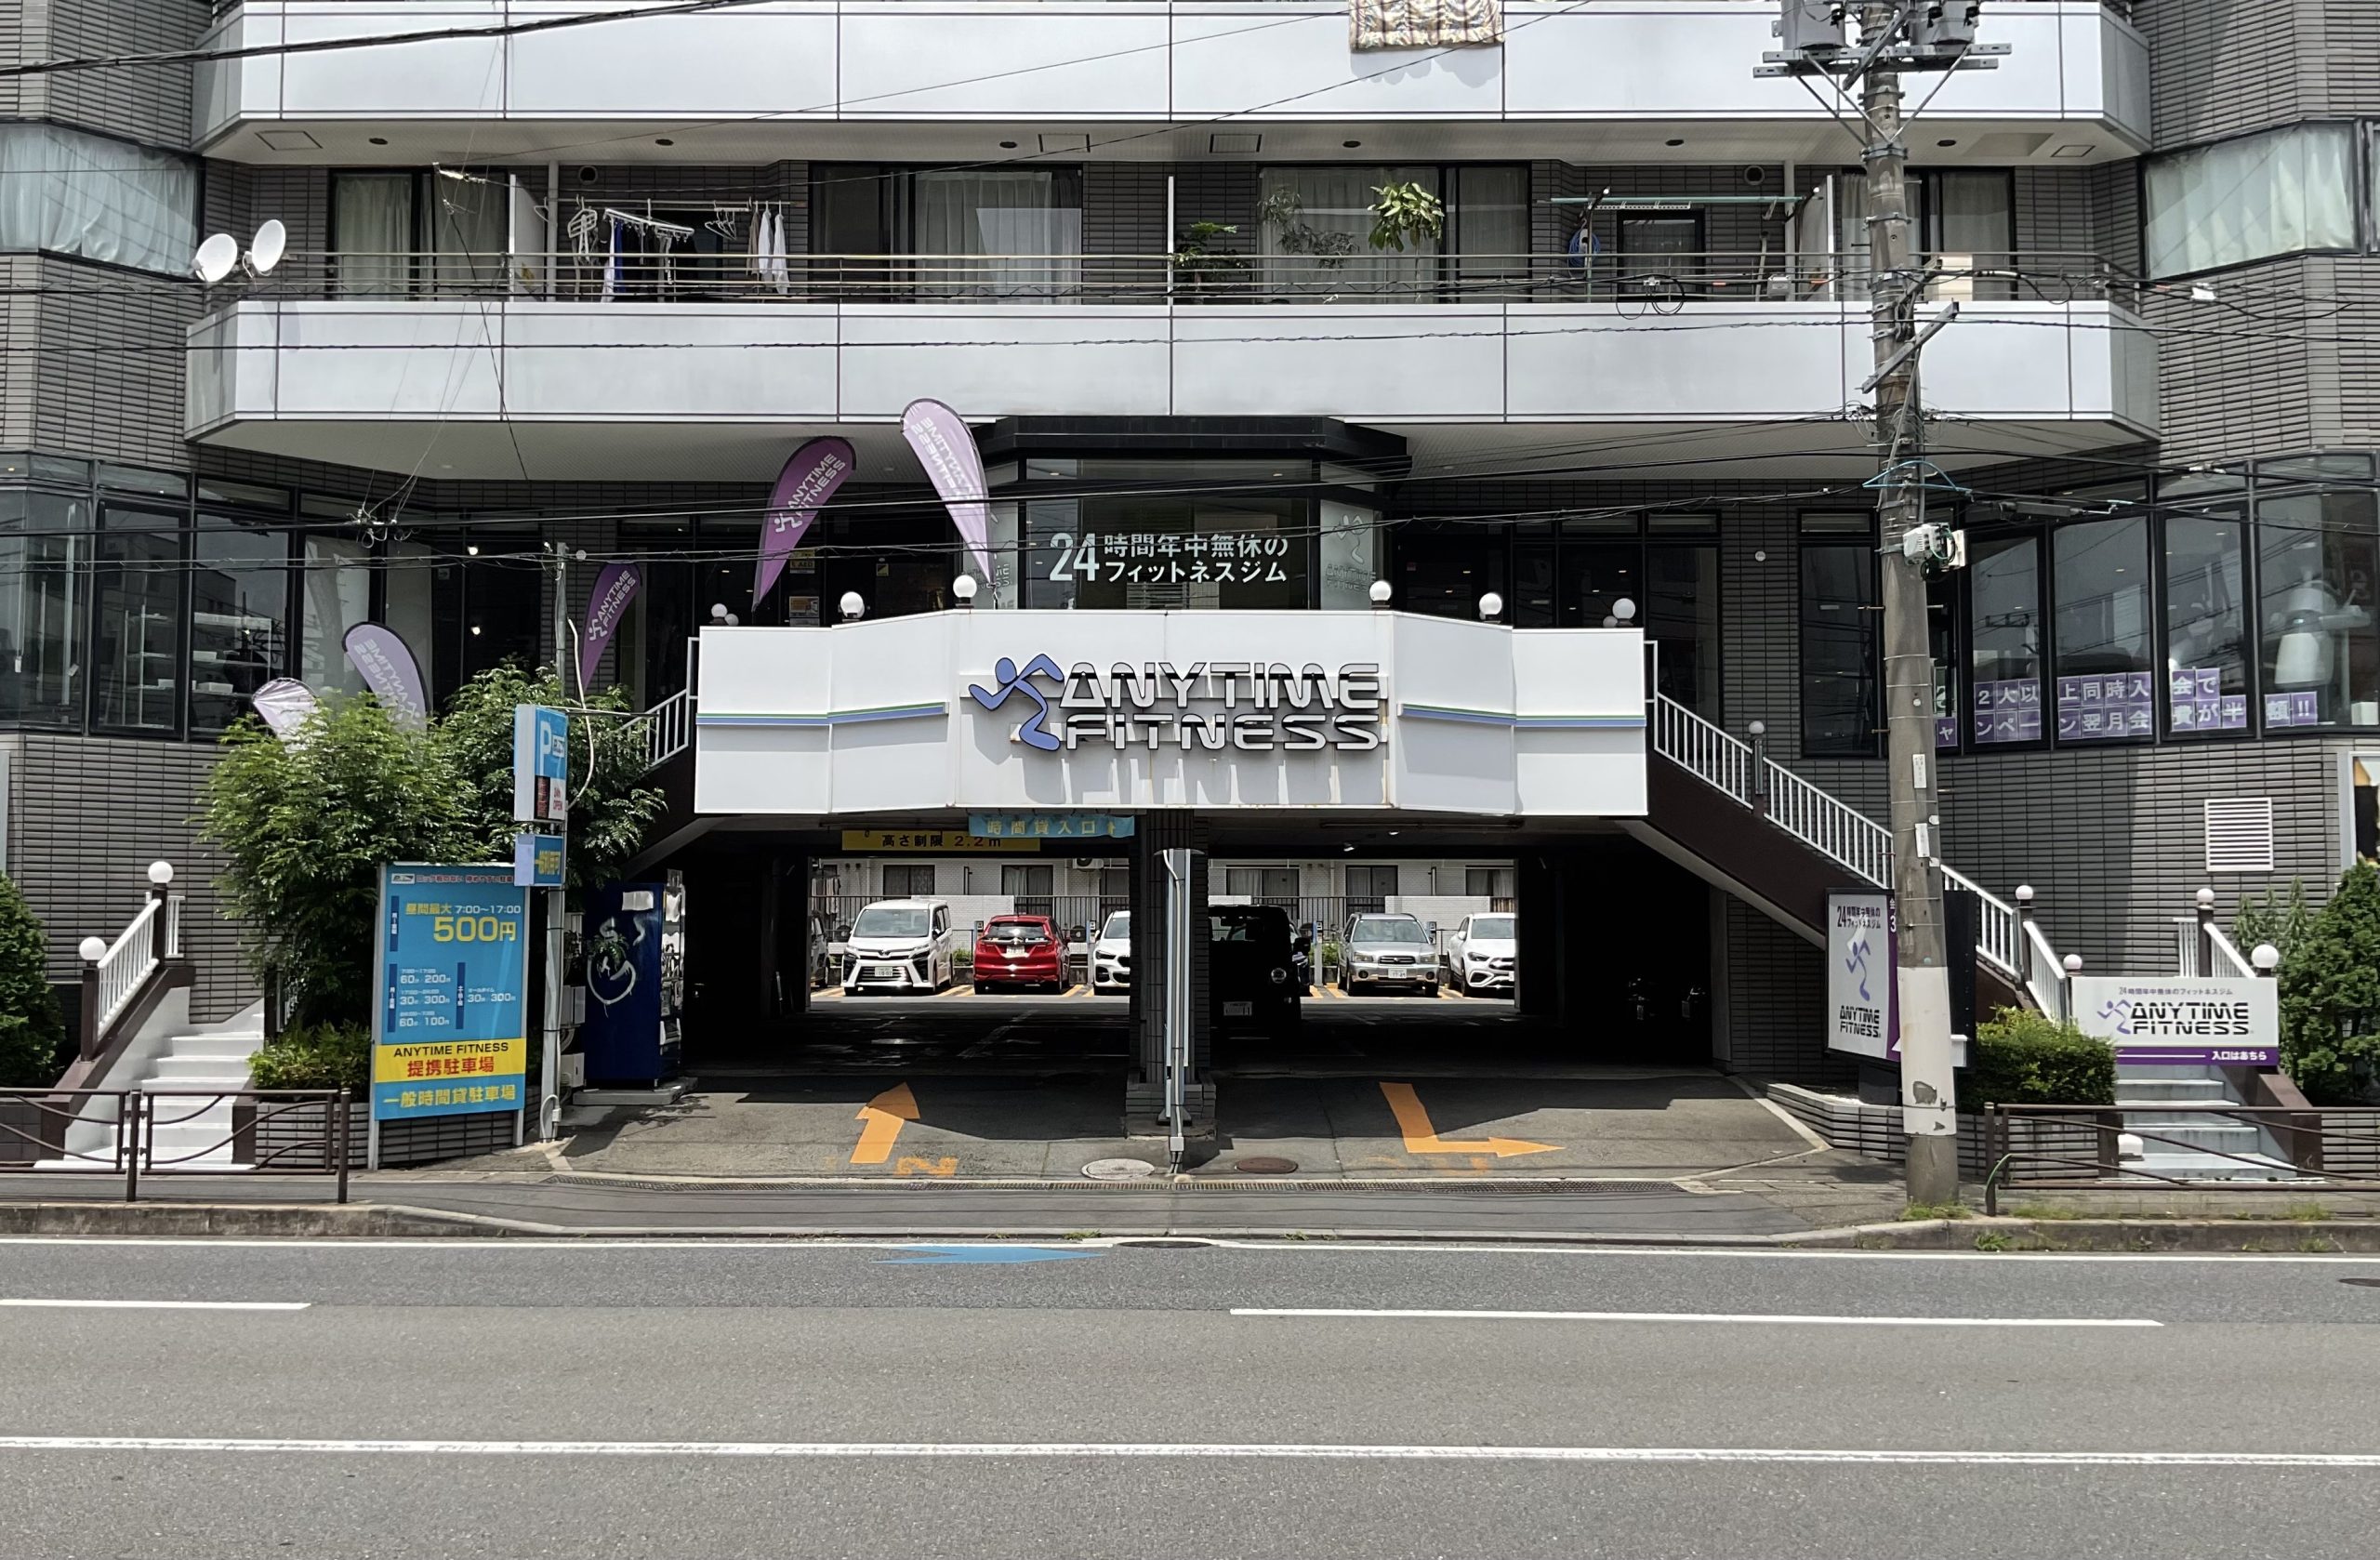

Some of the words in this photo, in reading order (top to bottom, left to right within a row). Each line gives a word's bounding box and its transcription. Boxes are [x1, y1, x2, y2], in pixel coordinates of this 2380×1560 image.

[1050, 533, 1099, 582] 24
[1104, 534, 1289, 558] 時間年中無休の
[1104, 561, 1288, 583] フィットネスジム
[598, 571, 630, 621] ANYTIME
[602, 577, 636, 628] FITNESS
[1059, 662, 1380, 709] ANYTIME
[1065, 714, 1380, 751] FITNESS
[540, 721, 551, 775] P
[882, 836, 943, 847] 高さ制限
[1837, 906, 1846, 928] 24
[433, 917, 516, 942] 500円
[1840, 1005, 1880, 1024] ANYTIME
[2130, 1002, 2249, 1020] ANYTIME
[1840, 1021, 1879, 1038] FITNESS
[2133, 1021, 2249, 1035] FITNESS
[394, 1046, 452, 1057] ANYTIME
[456, 1042, 509, 1052] FITNESS
[407, 1056, 495, 1077] 提携駐車場
[383, 1084, 516, 1107] 一般時間貸駐車場
